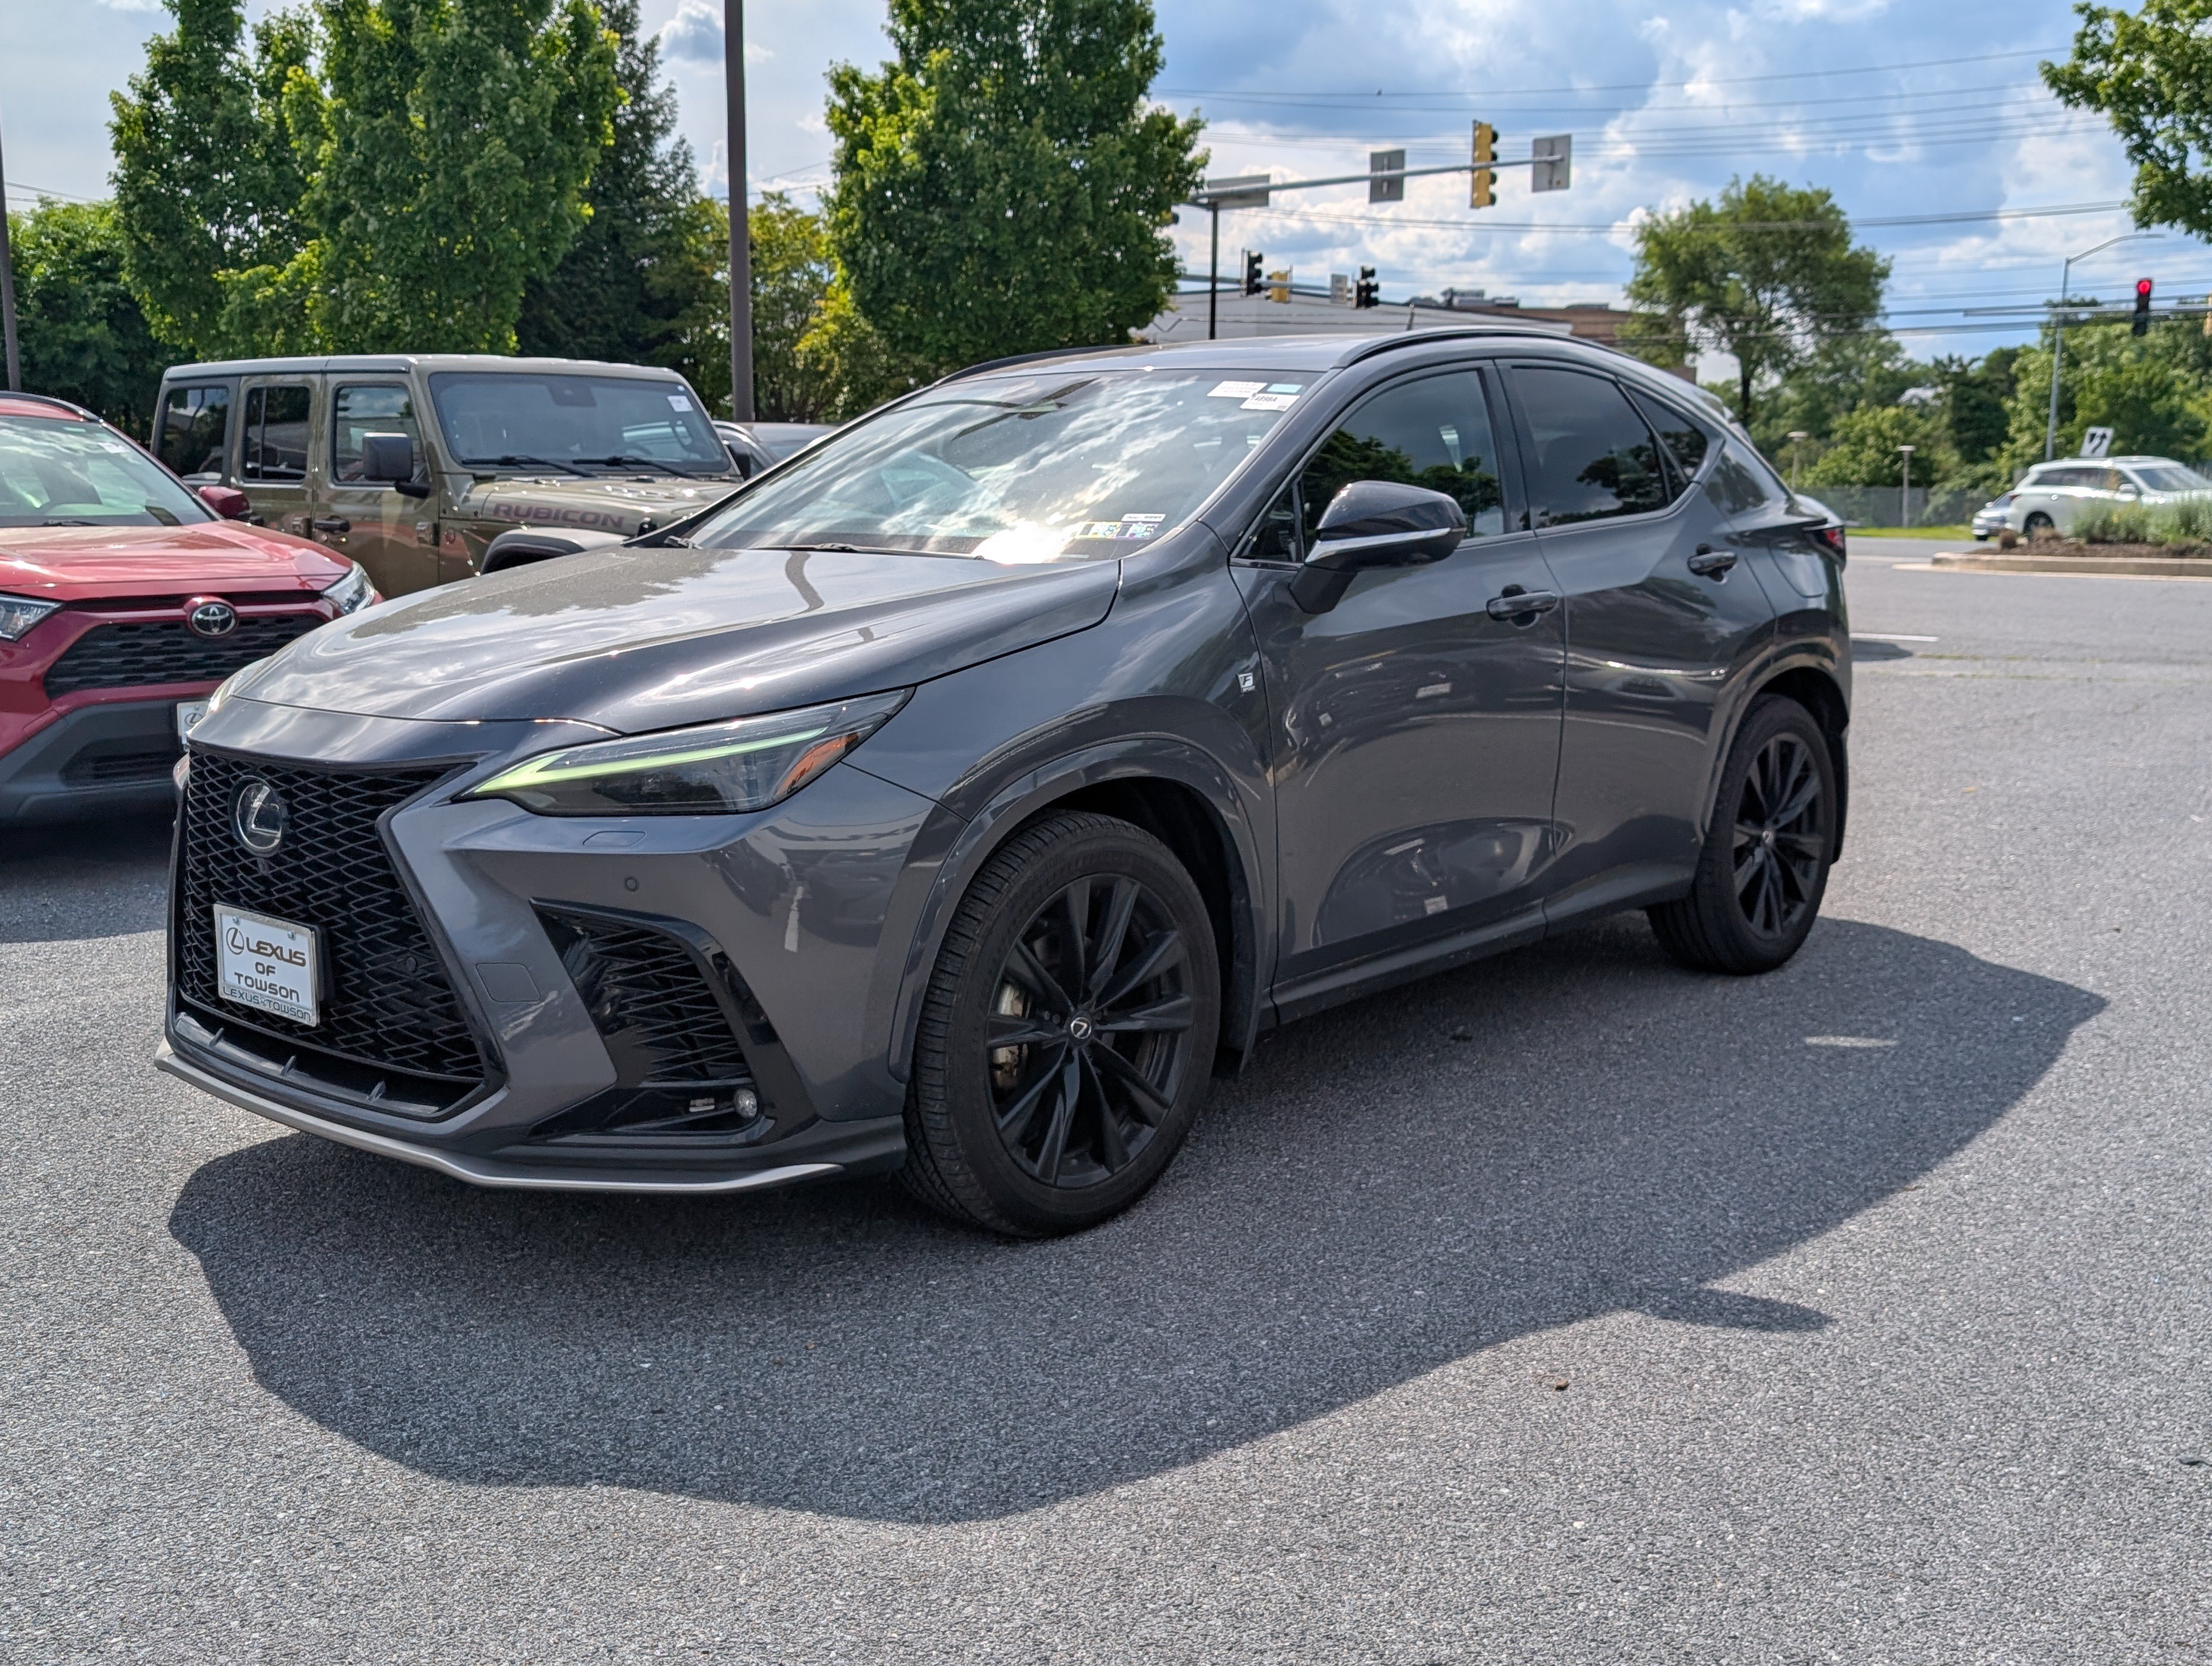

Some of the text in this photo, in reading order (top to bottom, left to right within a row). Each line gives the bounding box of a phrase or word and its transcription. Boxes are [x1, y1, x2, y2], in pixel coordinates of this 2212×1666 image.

[493, 503, 624, 528] RUBICON
[246, 937, 306, 967] LEXUS
[255, 962, 276, 976] OF
[234, 972, 300, 1002] TOWSON
[223, 986, 259, 1004] LEXUS
[266, 999, 311, 1022] TOWSON
